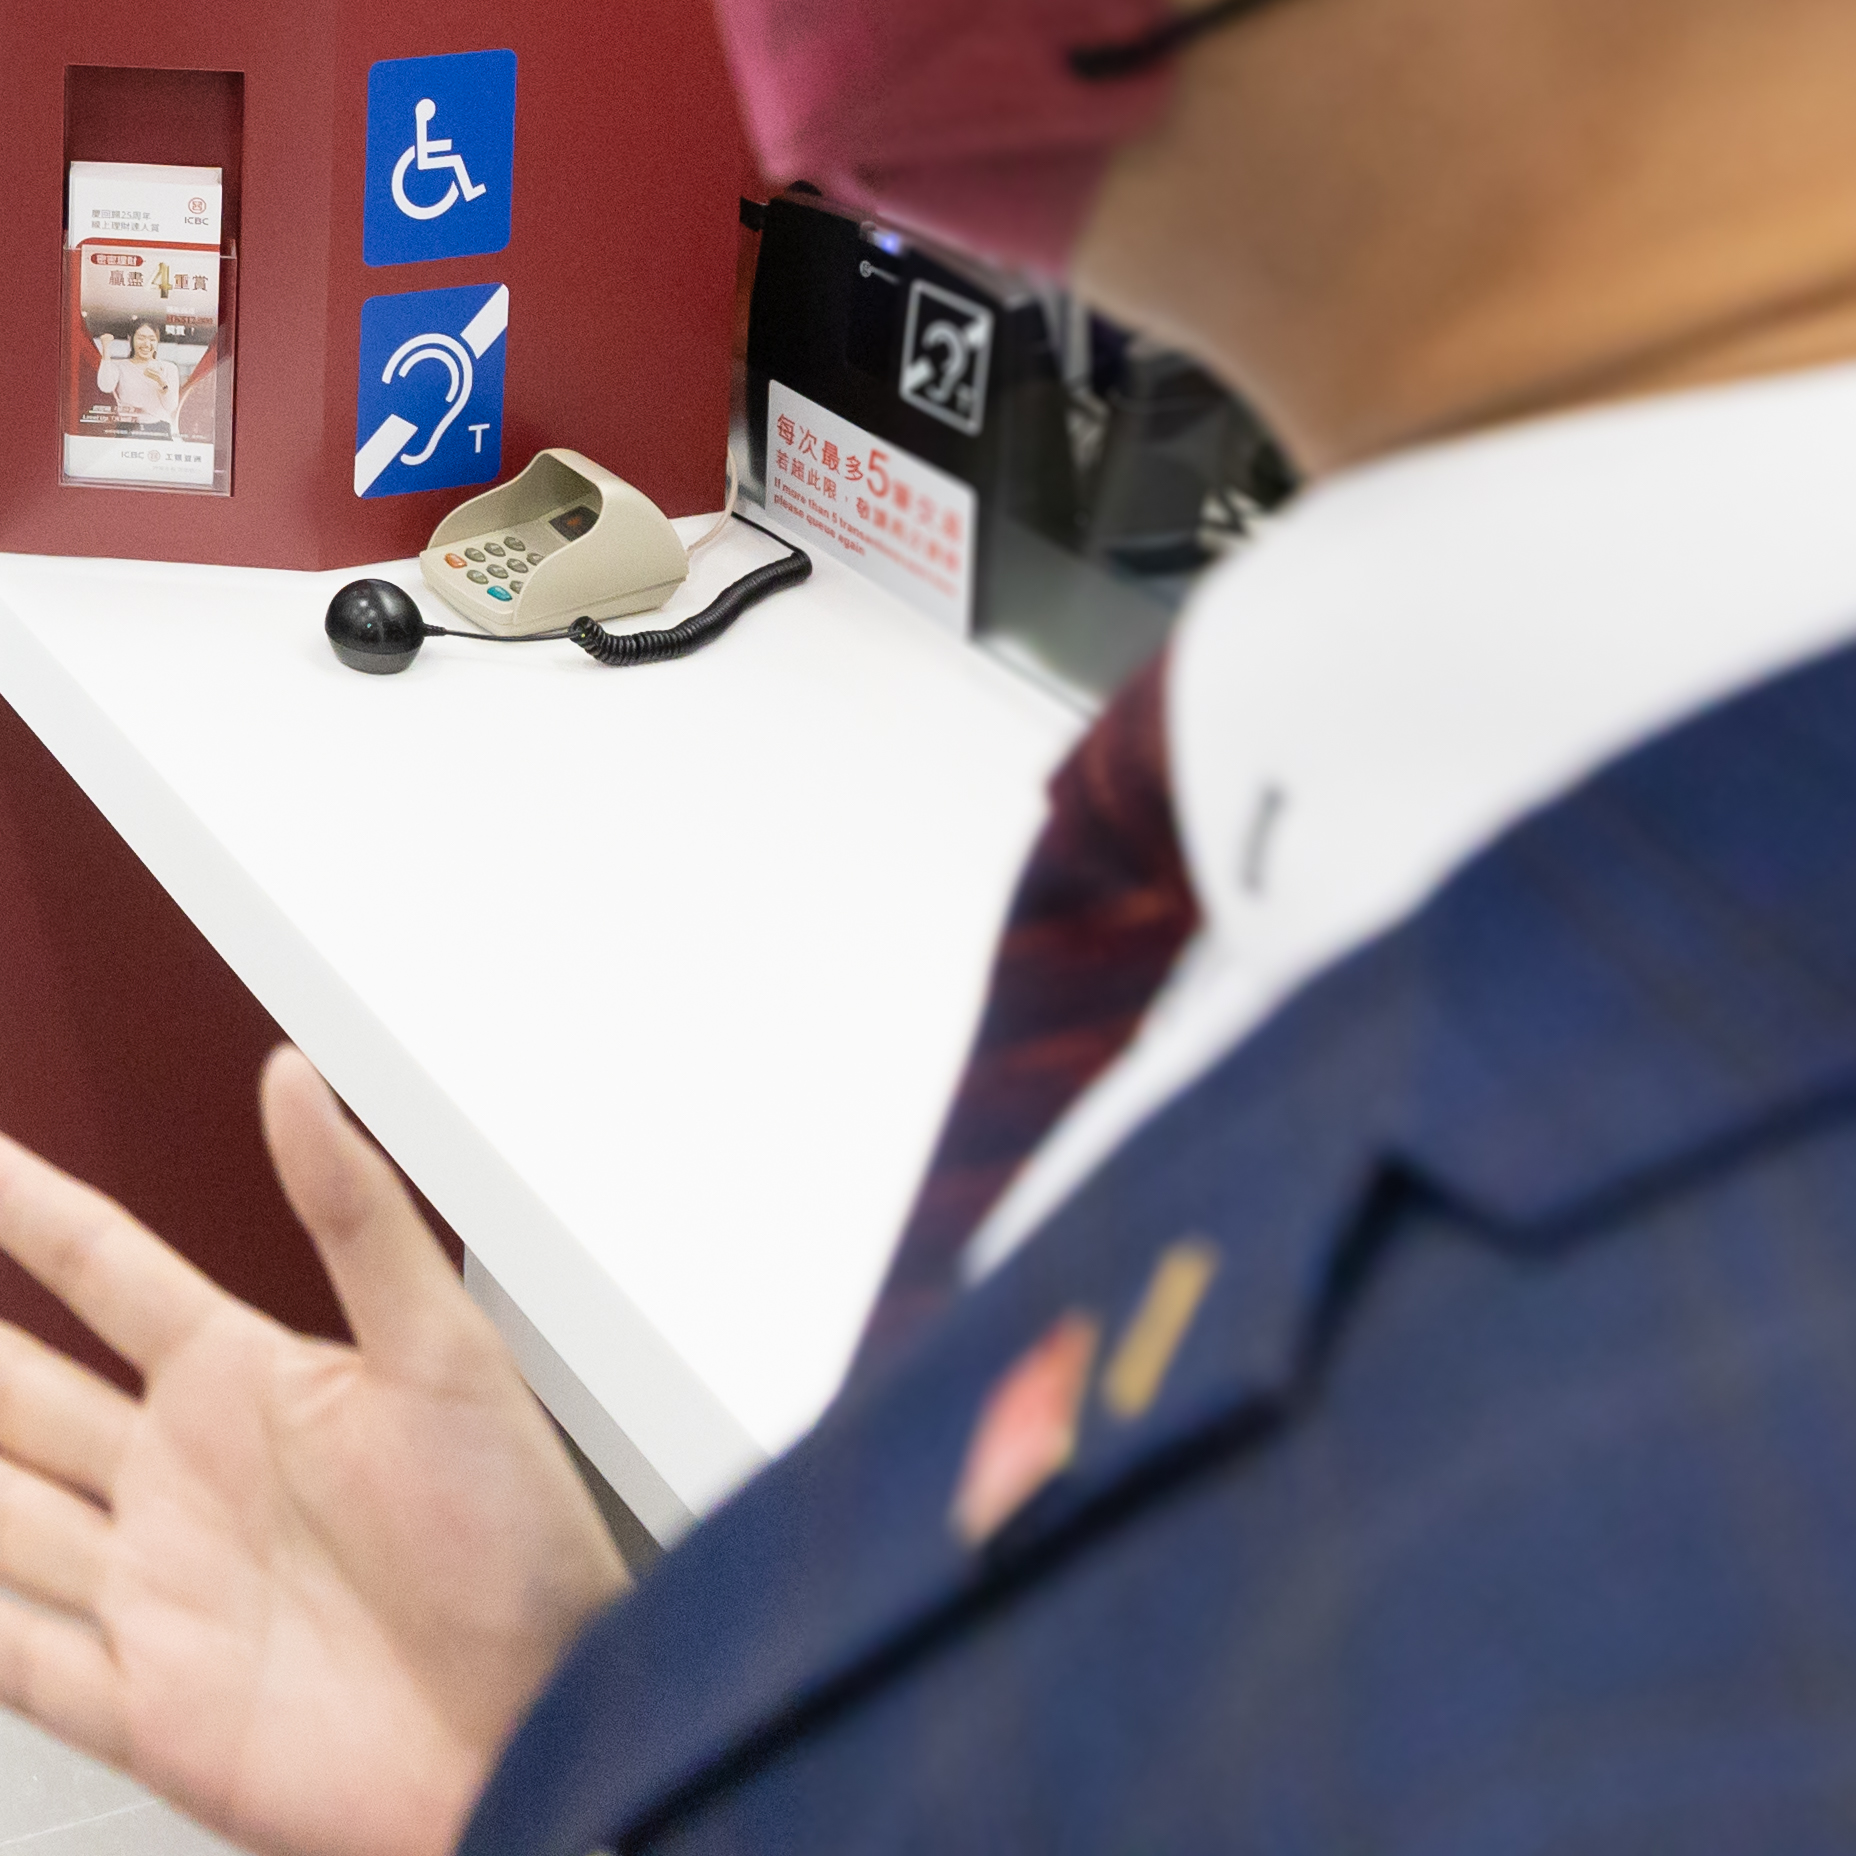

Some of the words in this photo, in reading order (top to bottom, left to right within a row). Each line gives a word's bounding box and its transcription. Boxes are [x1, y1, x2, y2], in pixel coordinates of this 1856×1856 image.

[184, 216, 209, 226] ICBC
[121, 450, 145, 460] ICBC
[468, 423, 491, 453] T
[777, 414, 963, 542] 每次最多5
[774, 476, 781, 489] If
[782, 484, 807, 505] more
[809, 498, 830, 519] than
[832, 511, 838, 524] 5
[773, 494, 805, 519] please
[806, 514, 836, 539] queue
[838, 533, 866, 557] again
